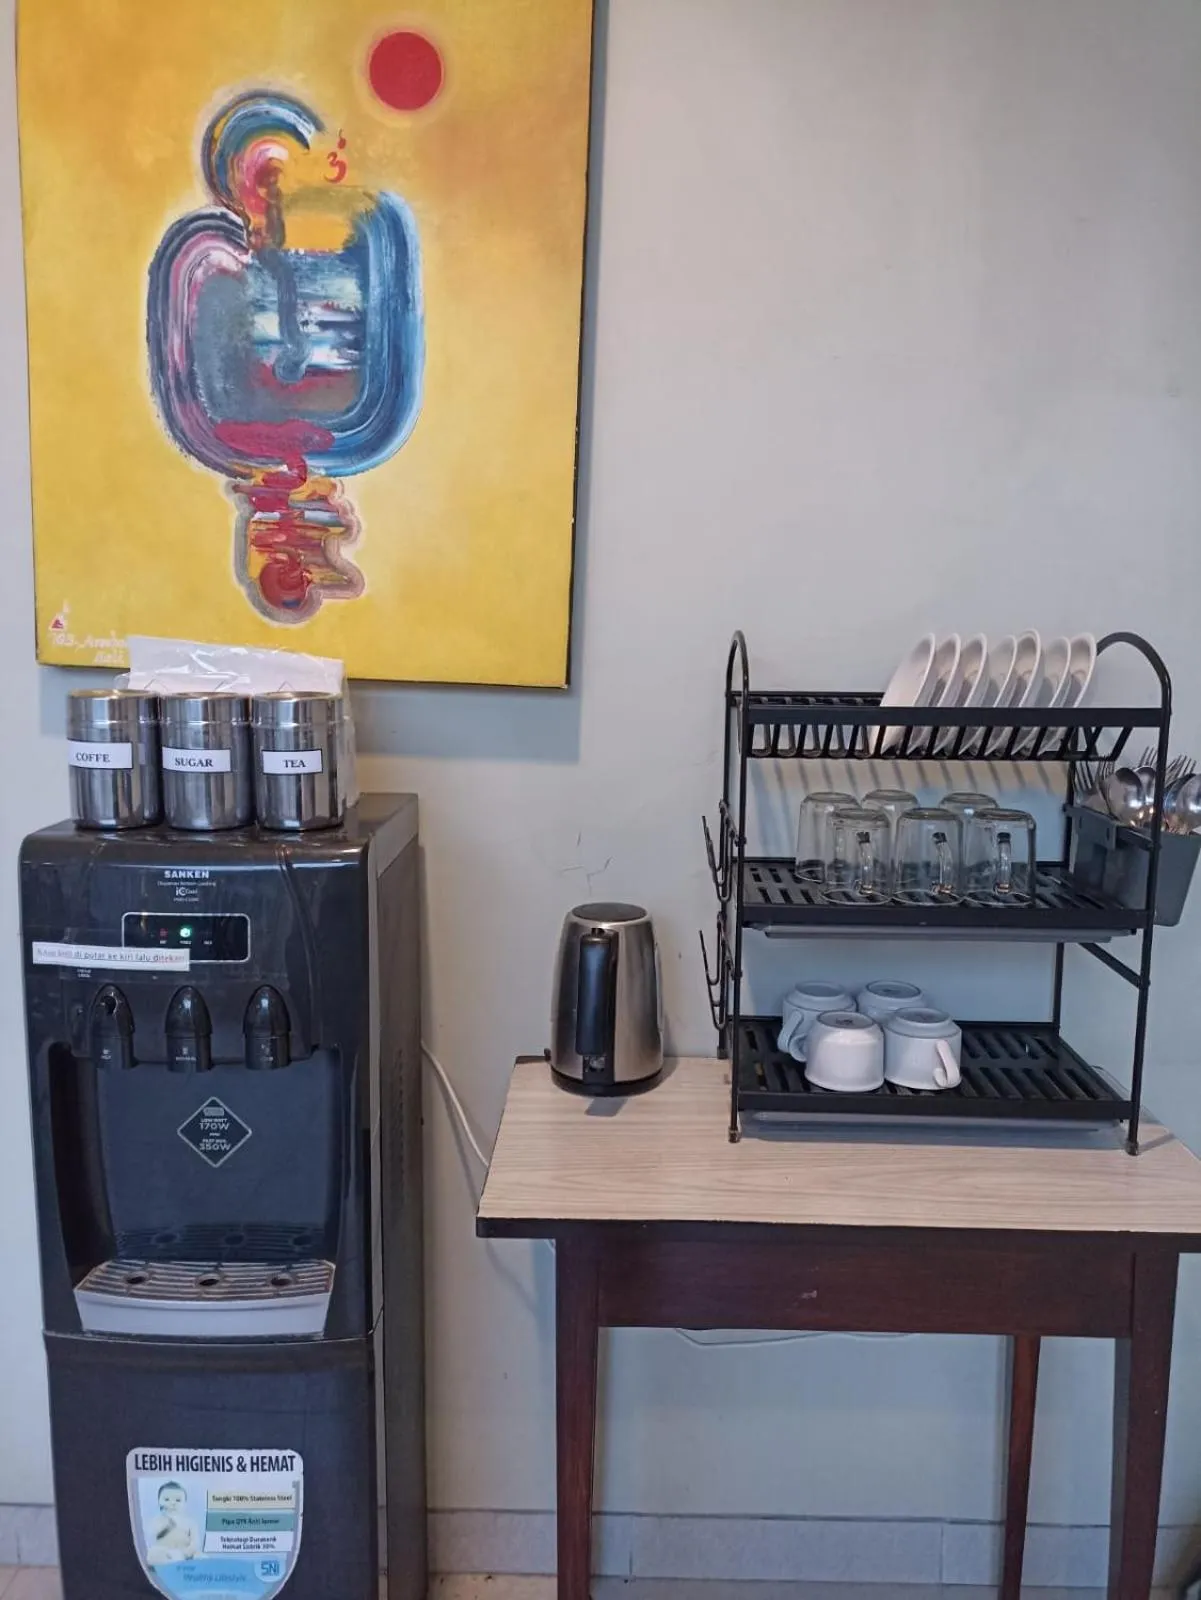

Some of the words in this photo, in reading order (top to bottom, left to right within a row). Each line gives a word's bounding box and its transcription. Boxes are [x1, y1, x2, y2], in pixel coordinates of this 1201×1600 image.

[75, 752, 111, 763] COFFE
[174, 757, 214, 768] SUGAR
[282, 758, 307, 768] TEA
[164, 870, 210, 878] SANKEN
[199, 1122, 230, 1130] 170W
[134, 1453, 172, 1471] LEBIH
[176, 1455, 233, 1472] HIGIENIS
[236, 1455, 247, 1472] &
[250, 1455, 296, 1472] HEMAT
[261, 1561, 280, 1576] SNI
